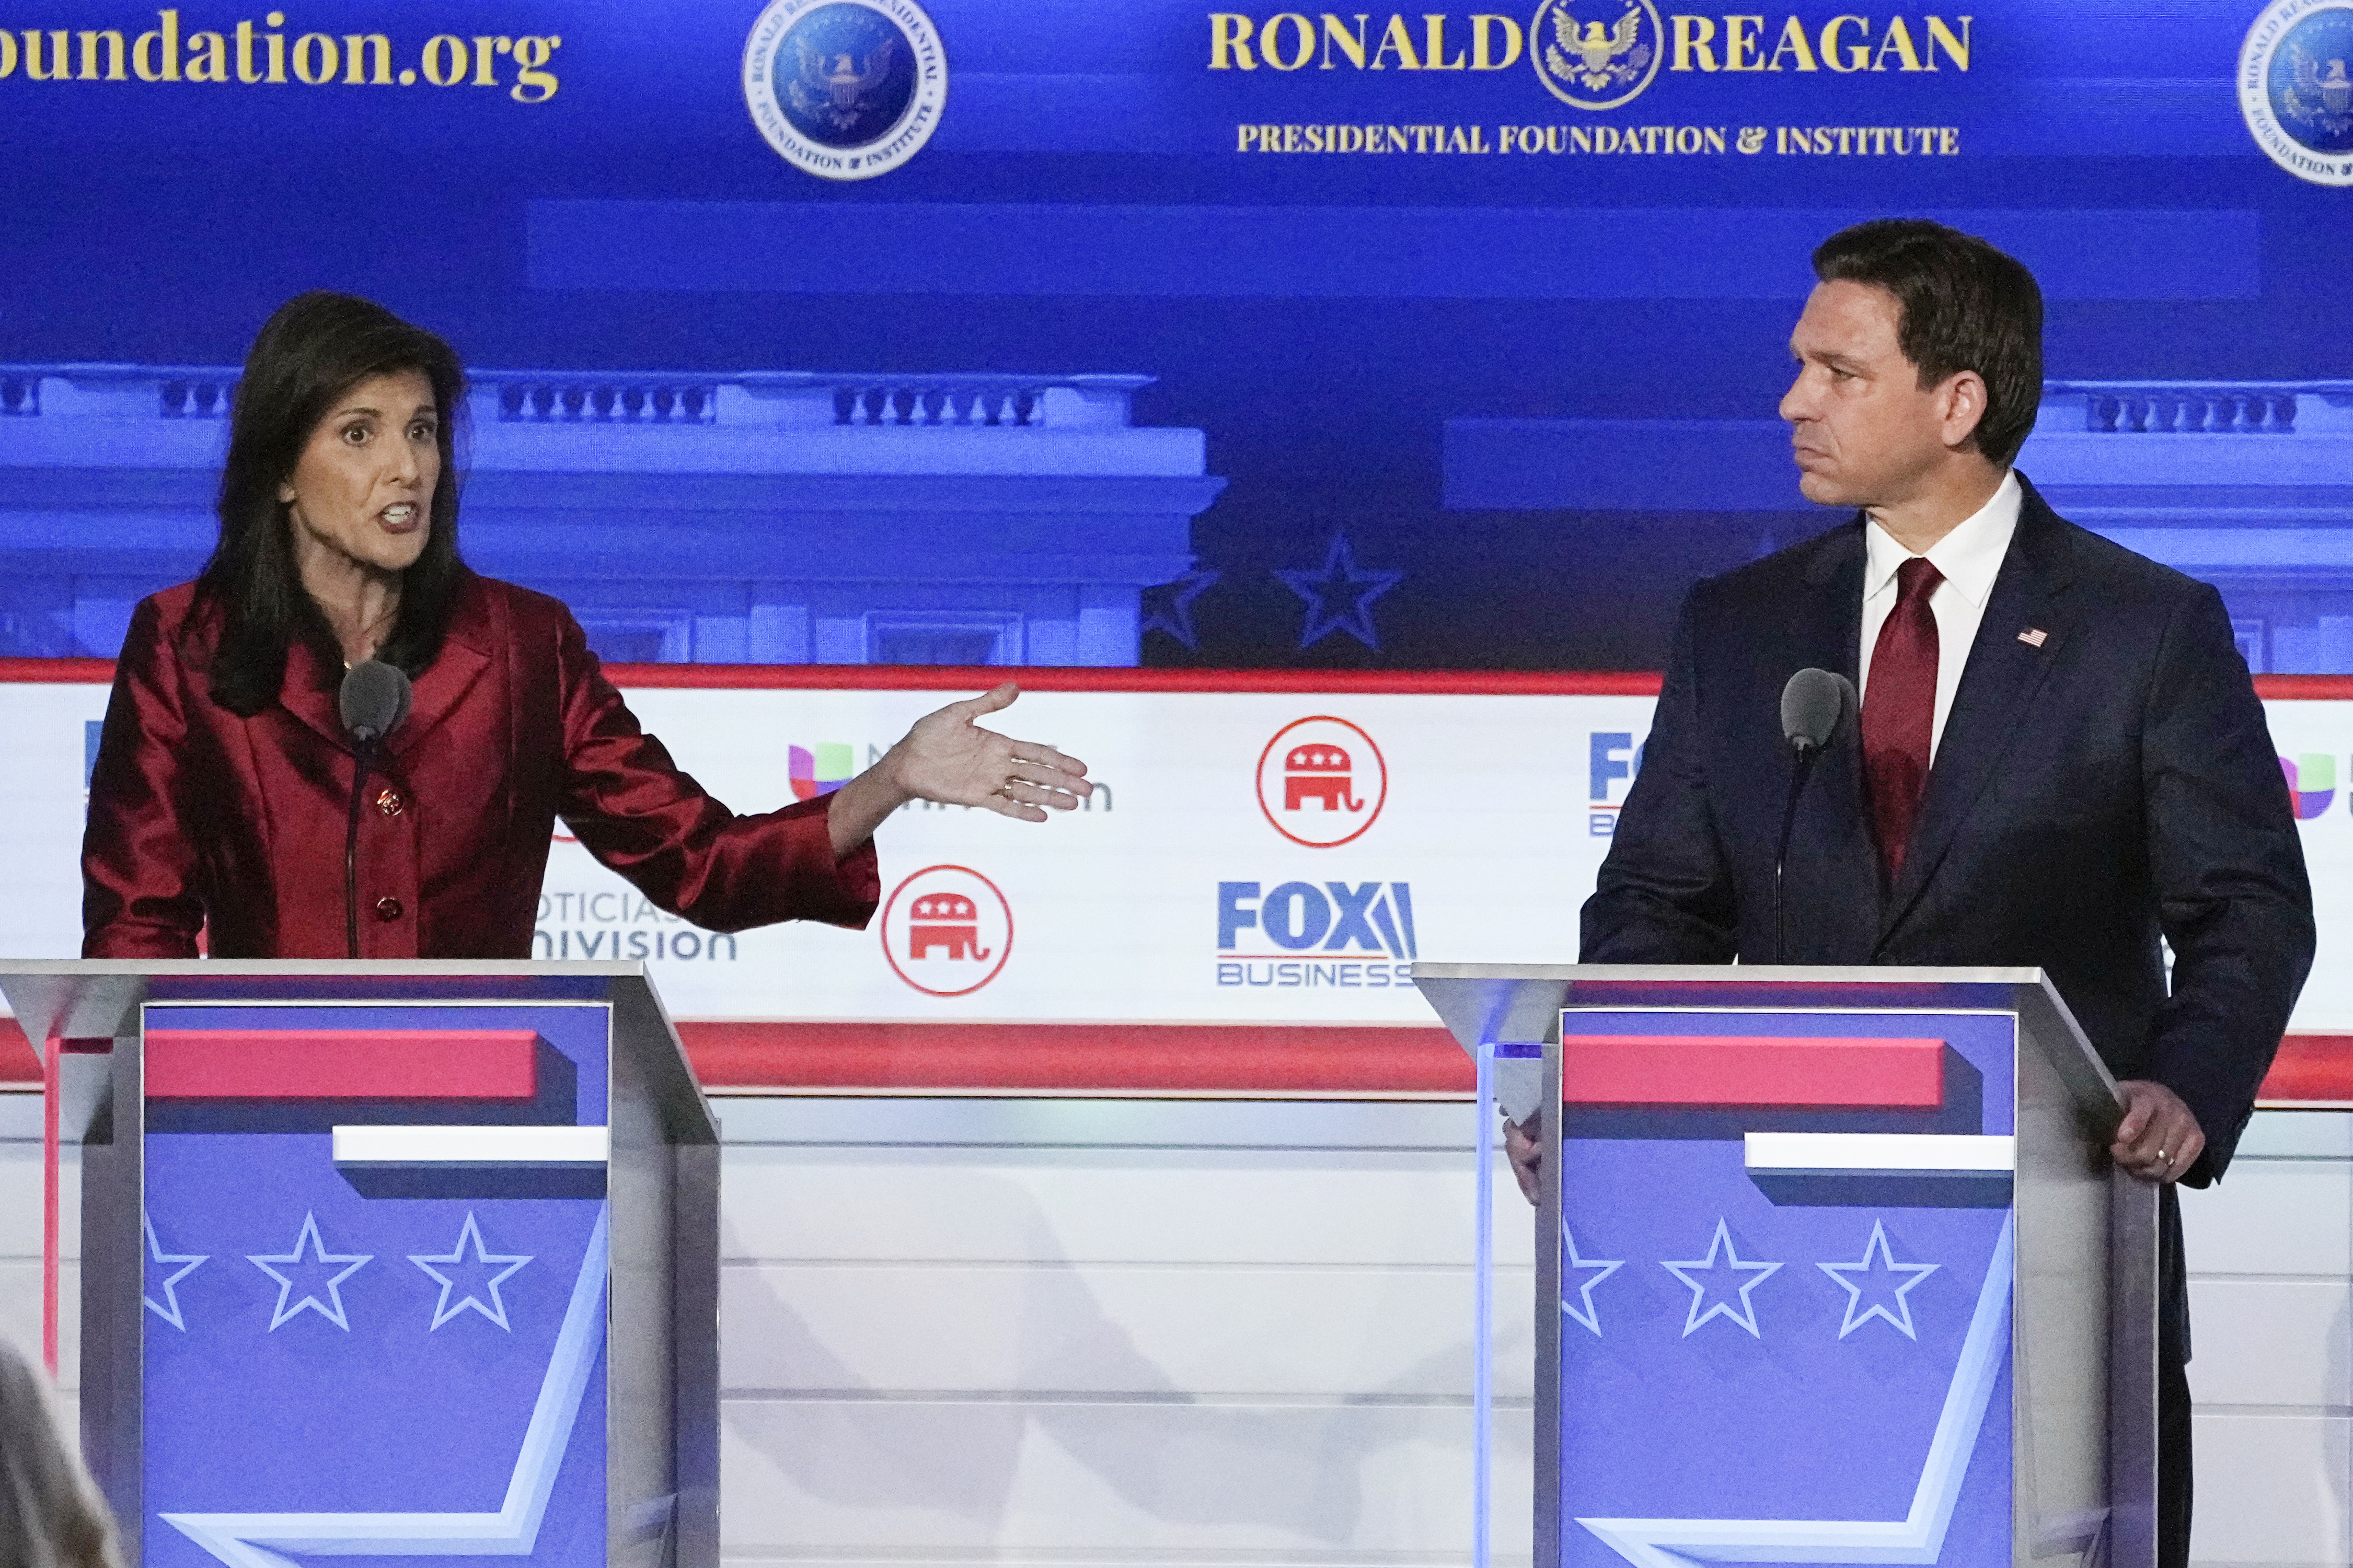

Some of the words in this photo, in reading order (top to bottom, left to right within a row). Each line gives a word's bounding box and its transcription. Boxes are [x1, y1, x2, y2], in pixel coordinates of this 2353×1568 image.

[1207, 13, 1522, 71] RONALD
[1670, 15, 1973, 72] REAGAN
[1237, 124, 1490, 154] PRESIDENTIAL
[1498, 125, 1726, 155] FOUNDATION
[1736, 126, 1768, 155] &
[1777, 126, 1959, 156] INSTITUTE
[1217, 881, 1384, 950] FOX
[1217, 963, 1414, 988] BUSINESS
